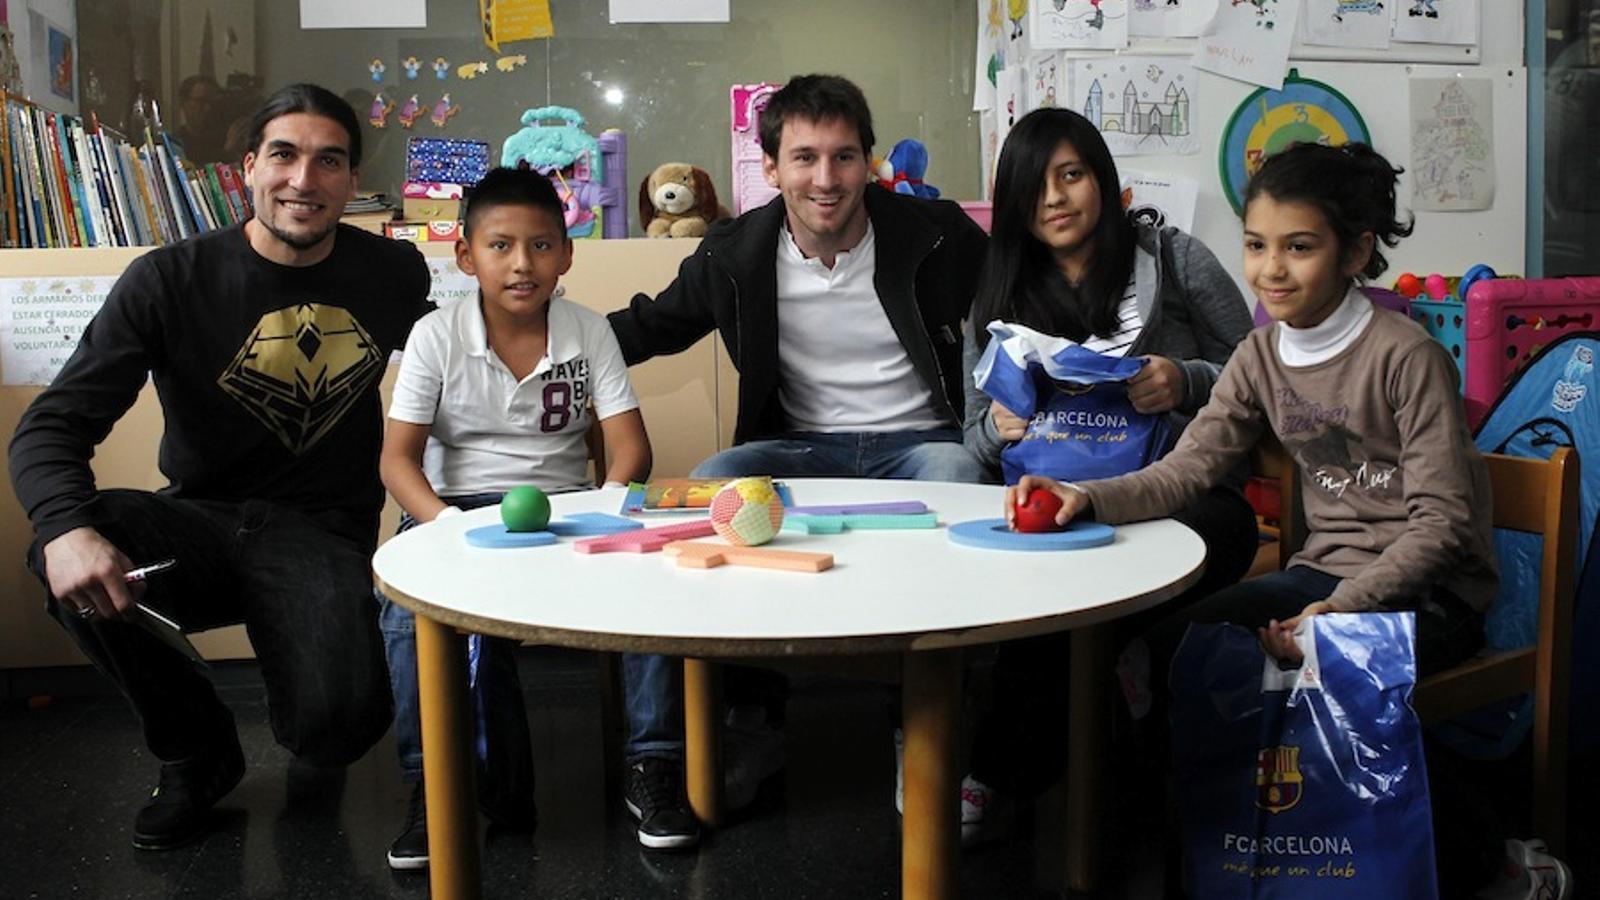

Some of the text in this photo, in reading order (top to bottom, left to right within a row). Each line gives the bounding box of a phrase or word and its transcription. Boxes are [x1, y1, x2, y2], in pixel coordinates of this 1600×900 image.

[1293, 105, 1309, 125] 3
[11, 295, 30, 305] LOS
[32, 293, 84, 305] ARMARIOS
[12, 309, 95, 320] ESTAR CERRADOS
[13, 324, 61, 335] AUSENCIA
[63, 325, 76, 334] DE
[541, 382, 571, 433] 8
[1030, 411, 1128, 427] BARCELONA
[1074, 432, 1093, 441] un
[1097, 430, 1129, 443] club
[1224, 833, 1353, 855] FCARCELONA
[1287, 866, 1310, 877] un
[1316, 860, 1356, 879] club
